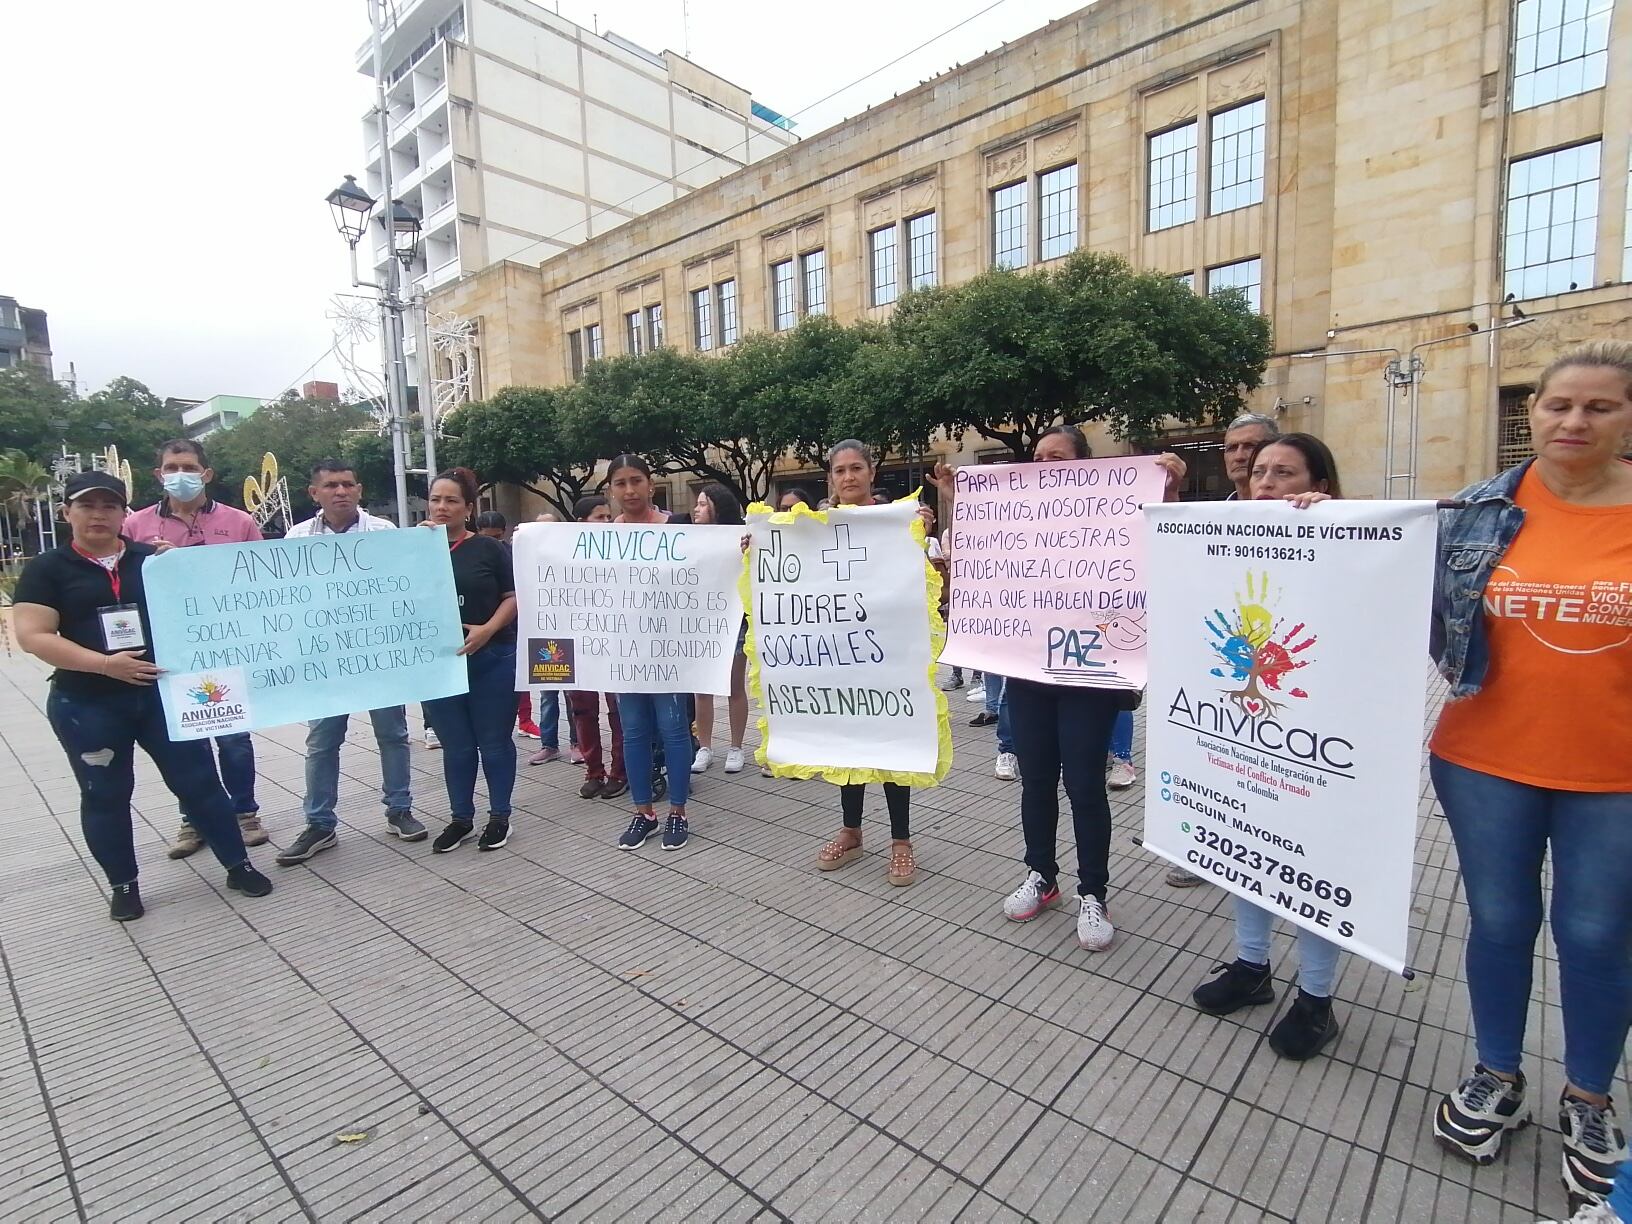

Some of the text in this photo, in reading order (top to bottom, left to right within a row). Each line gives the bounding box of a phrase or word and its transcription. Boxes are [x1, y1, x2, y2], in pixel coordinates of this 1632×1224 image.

[956, 466, 1138, 493] PARA EL ESTADO NO
[1037, 495, 1137, 521] NOSOTROS
[572, 530, 687, 562] ANIVICAC
[954, 527, 1131, 550] EXIGIMOS NUESTRAS
[1156, 521, 1404, 542] ASOCIACIÓN NACIONAL DE VÍCTIMAS
[231, 538, 373, 585] ANIVICAC
[758, 529, 801, 583] No
[1206, 544, 1316, 563] NIT: 901613621-3
[537, 565, 699, 586] LA LUCHA POR LOS
[953, 558, 1136, 582] INDEMNIZACIONES
[185, 575, 411, 617] EL VERDADERO PROGRESO
[537, 588, 727, 611] DERECHOS HUMANOS ES
[760, 592, 868, 626] LIDERES
[952, 588, 1147, 610] PARA QUE HABLEN DE UN
[187, 599, 416, 645] SOCIAL NO CONSISTE EN
[537, 611, 729, 635] EN ESENCIA UNA LUCHA
[951, 617, 1032, 638] VERDADERA
[190, 620, 440, 671] AUMENTAR LAS NECESIDADES
[582, 636, 722, 659] POR LA DIGNIDAD
[762, 629, 885, 668] SOCIALES
[253, 645, 435, 690] SINO EN REDUCIRLAS
[533, 664, 570, 673] ANIVICAC
[610, 663, 679, 682] HUMANA
[182, 704, 243, 721] ANIVICAC
[767, 683, 914, 717] ASESINADOS
[1168, 686, 1355, 770] Anivicac
[1196, 735, 1328, 788] Asociación Nacional de Integración de
[1172, 774, 1248, 814] @ANIVICAC1
[1236, 762, 1246, 775] del
[1247, 767, 1278, 787] Conflicto
[1279, 779, 1311, 798] Armado
[1236, 779, 1279, 801] en Colombia
[1172, 791, 1306, 857] @OLGUIN_MAYORGA
[1193, 824, 1352, 908] 3202378669
[1186, 849, 1356, 938] CUCUTA -N.DE S
